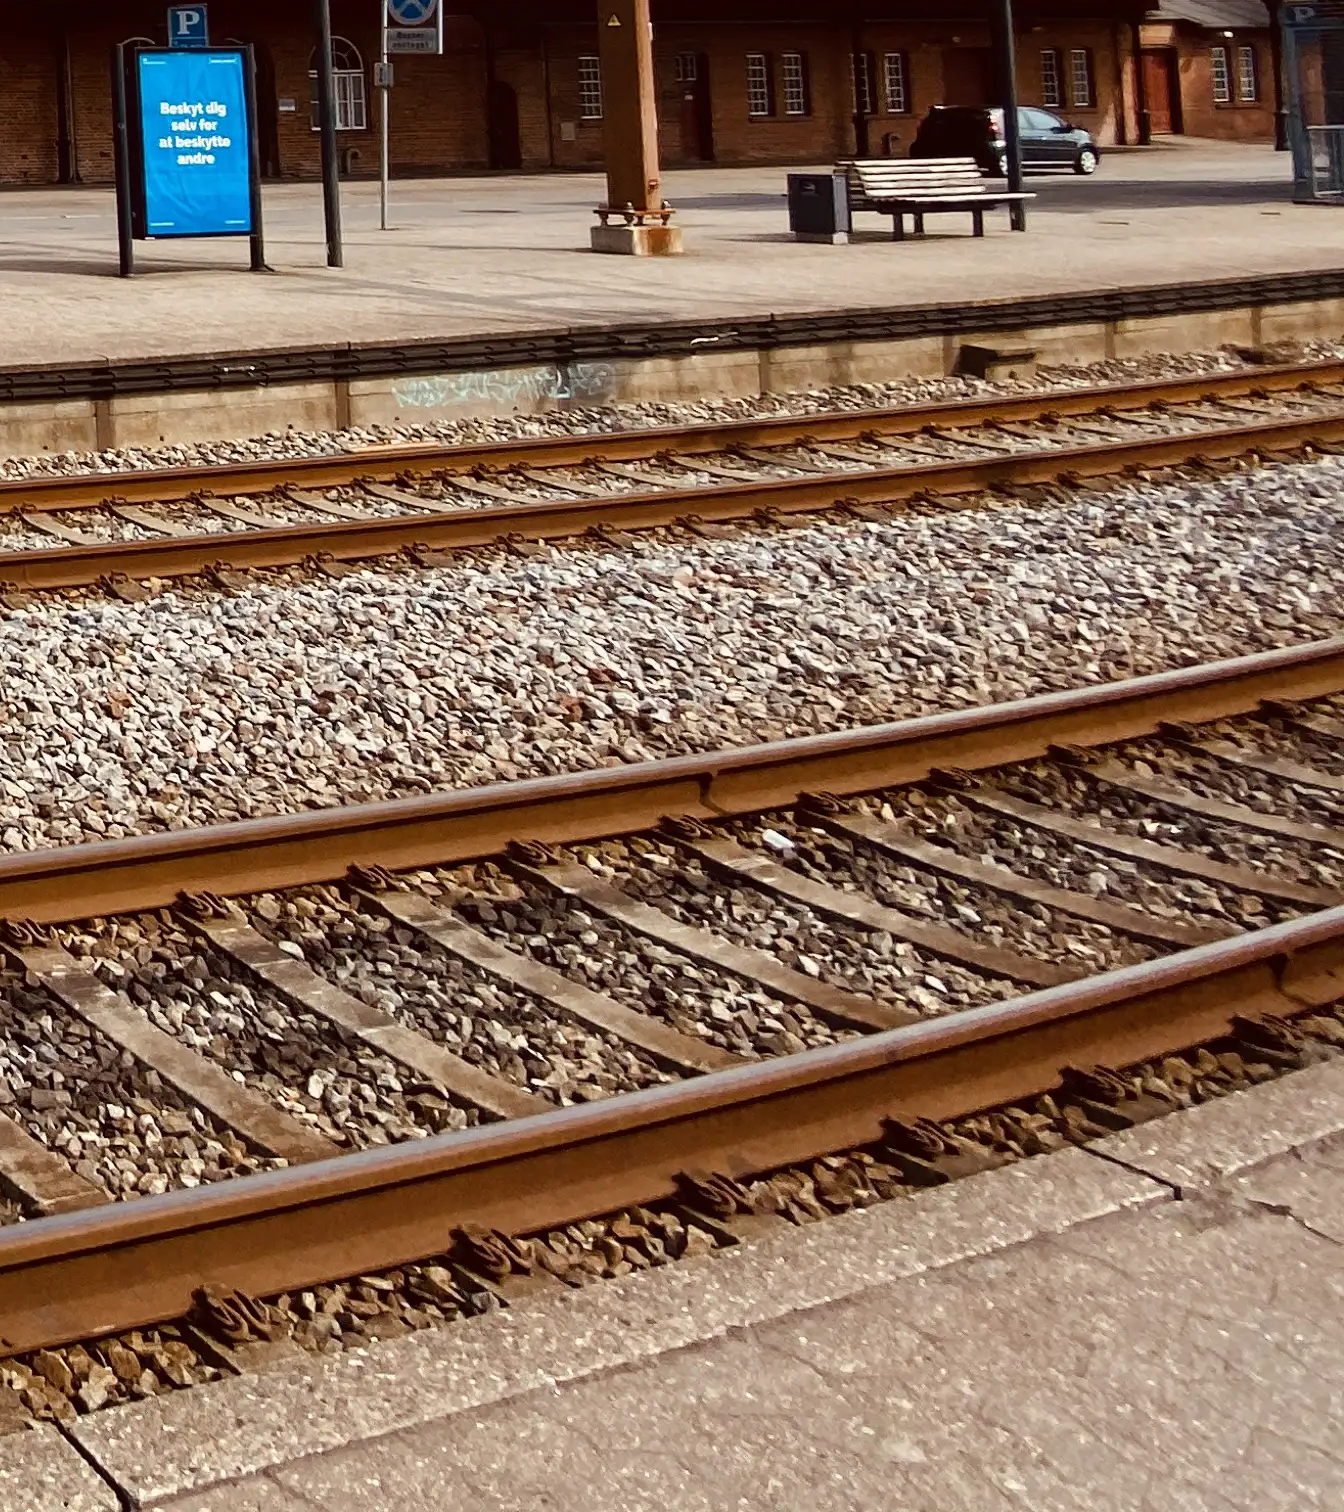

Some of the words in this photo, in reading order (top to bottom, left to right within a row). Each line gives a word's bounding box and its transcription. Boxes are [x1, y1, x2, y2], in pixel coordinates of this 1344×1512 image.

[176, 11, 200, 35] P
[160, 102, 204, 117] Beskyt
[206, 101, 227, 117] dig
[171, 119, 197, 131] selv
[199, 119, 218, 131] for
[159, 136, 173, 148] at
[175, 136, 231, 150] beskytte
[177, 152, 215, 165] andre
